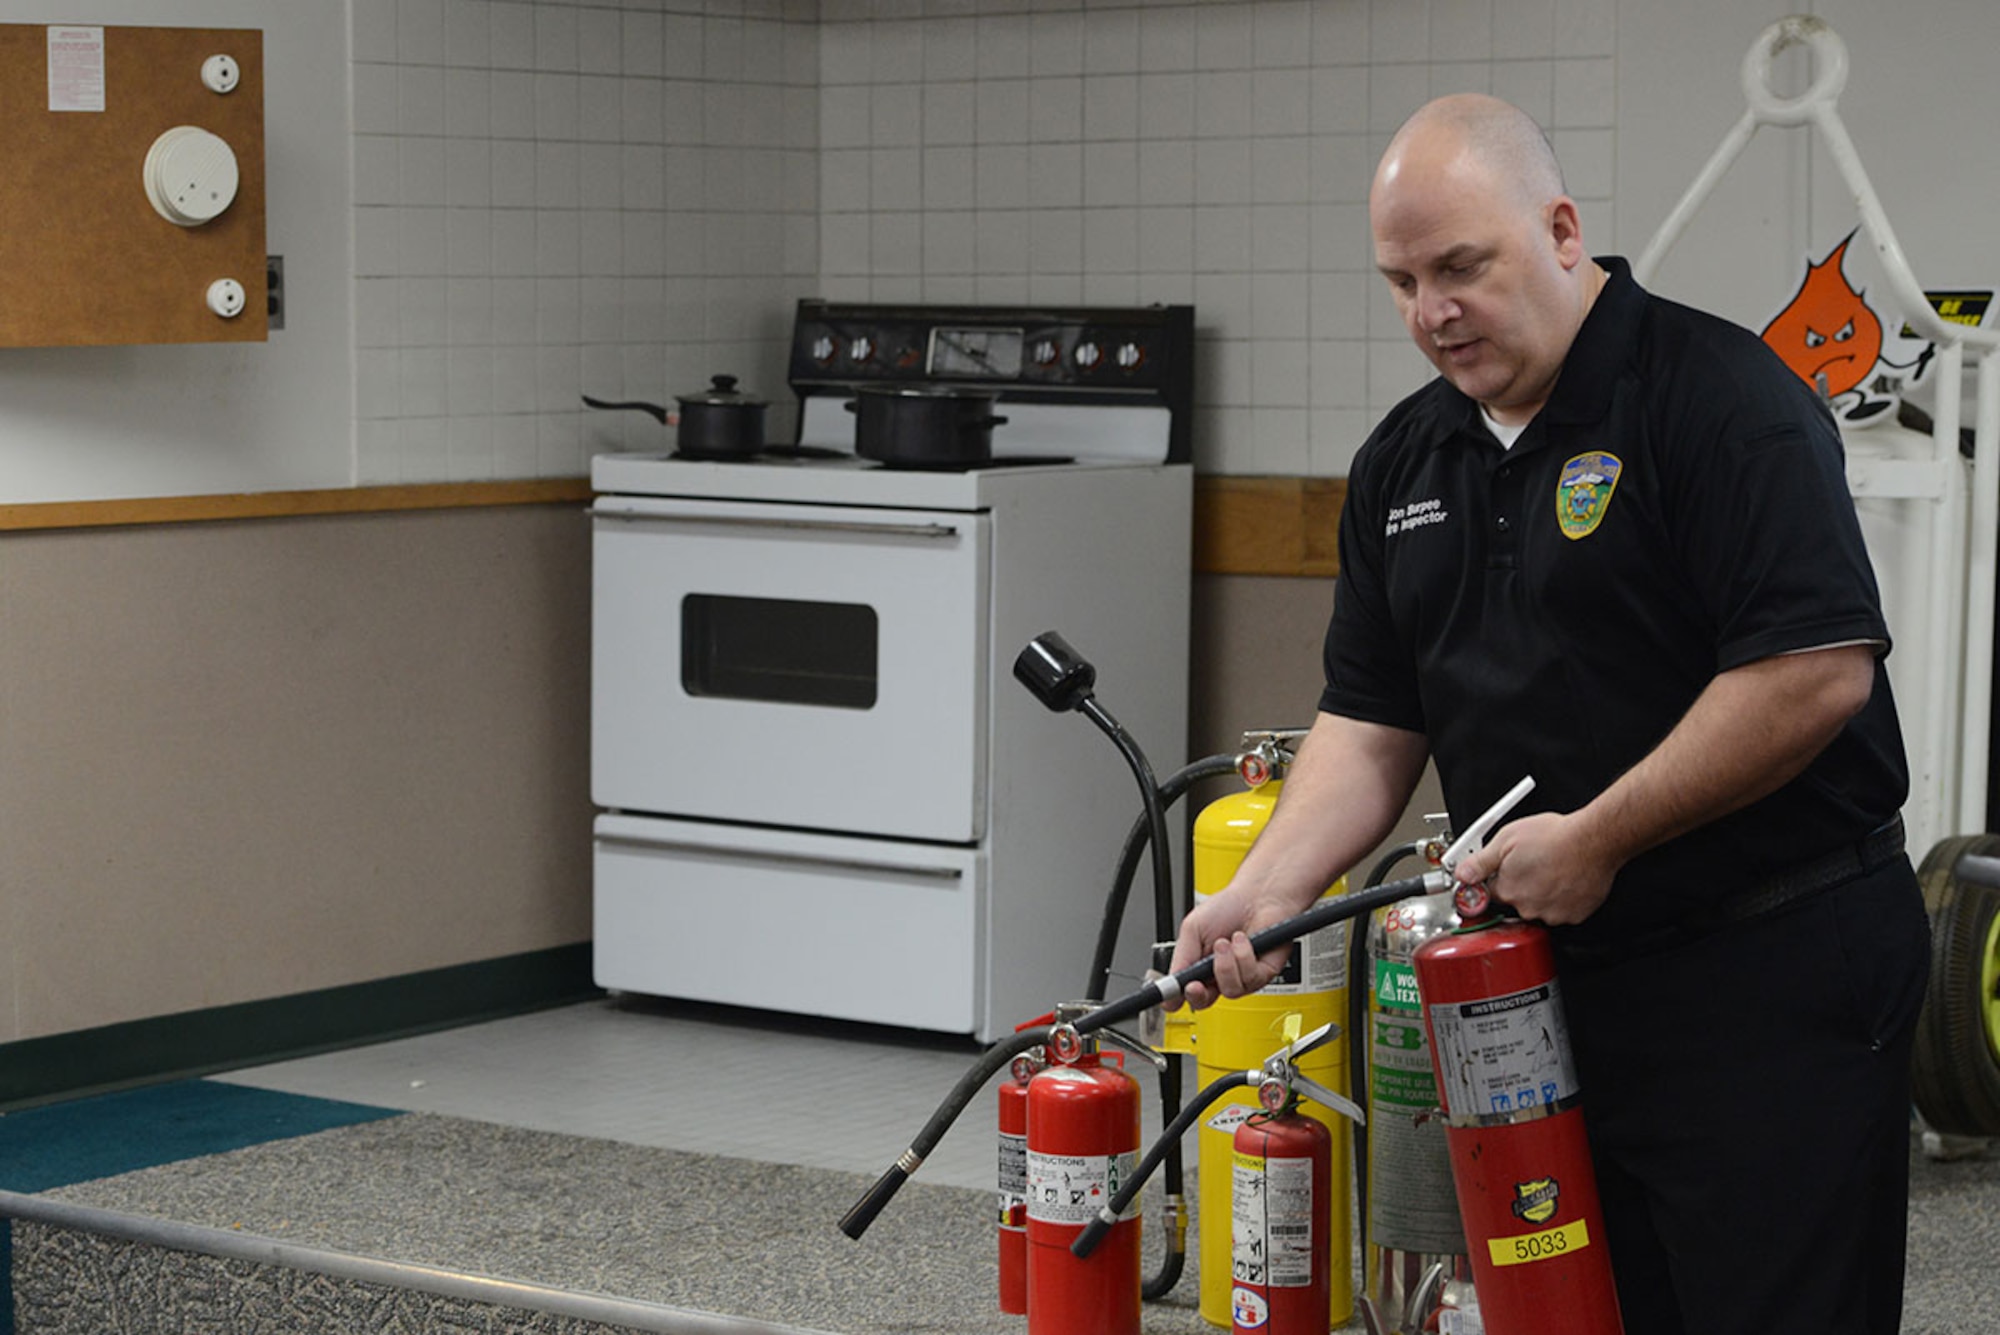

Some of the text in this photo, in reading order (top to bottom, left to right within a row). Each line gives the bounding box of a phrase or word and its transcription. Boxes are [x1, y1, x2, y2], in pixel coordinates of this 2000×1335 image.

[1401, 511, 1448, 531] Inspector
[1386, 909, 1416, 933] B3
[1470, 990, 1541, 1015] INSTRUCTIONS
[1515, 1231, 1567, 1259] 5033
